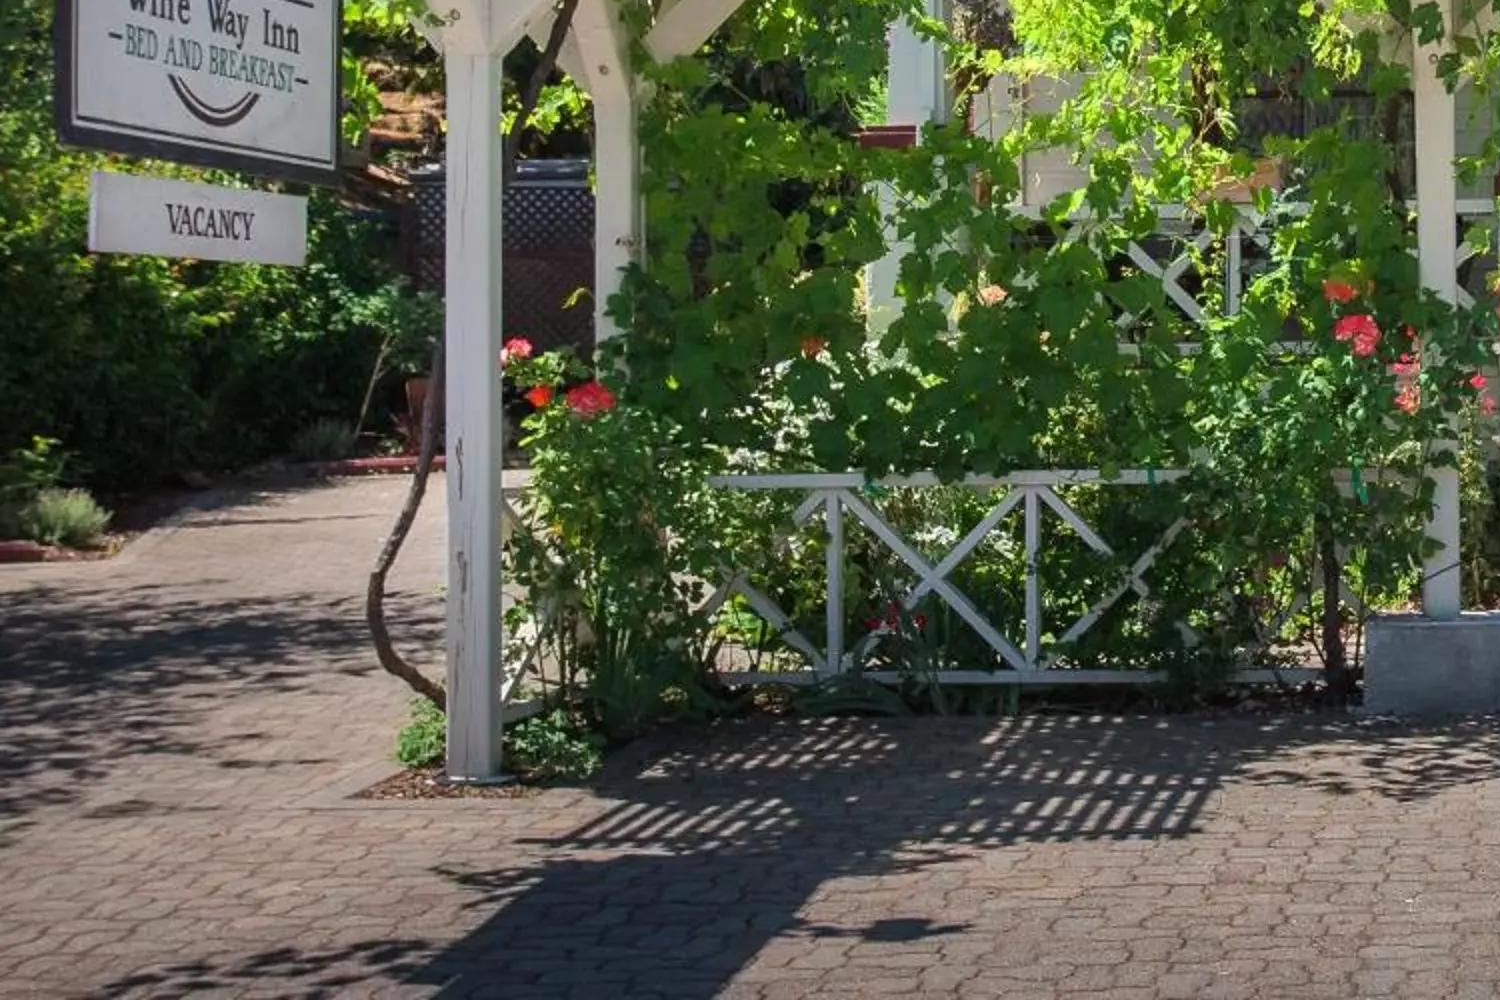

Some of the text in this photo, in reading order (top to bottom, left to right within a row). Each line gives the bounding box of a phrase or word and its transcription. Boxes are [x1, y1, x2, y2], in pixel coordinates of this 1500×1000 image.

[263, 9, 300, 54] Inn
[125, 24, 296, 92] BED AND BREAKFAST
[165, 203, 255, 241] VACANCY
